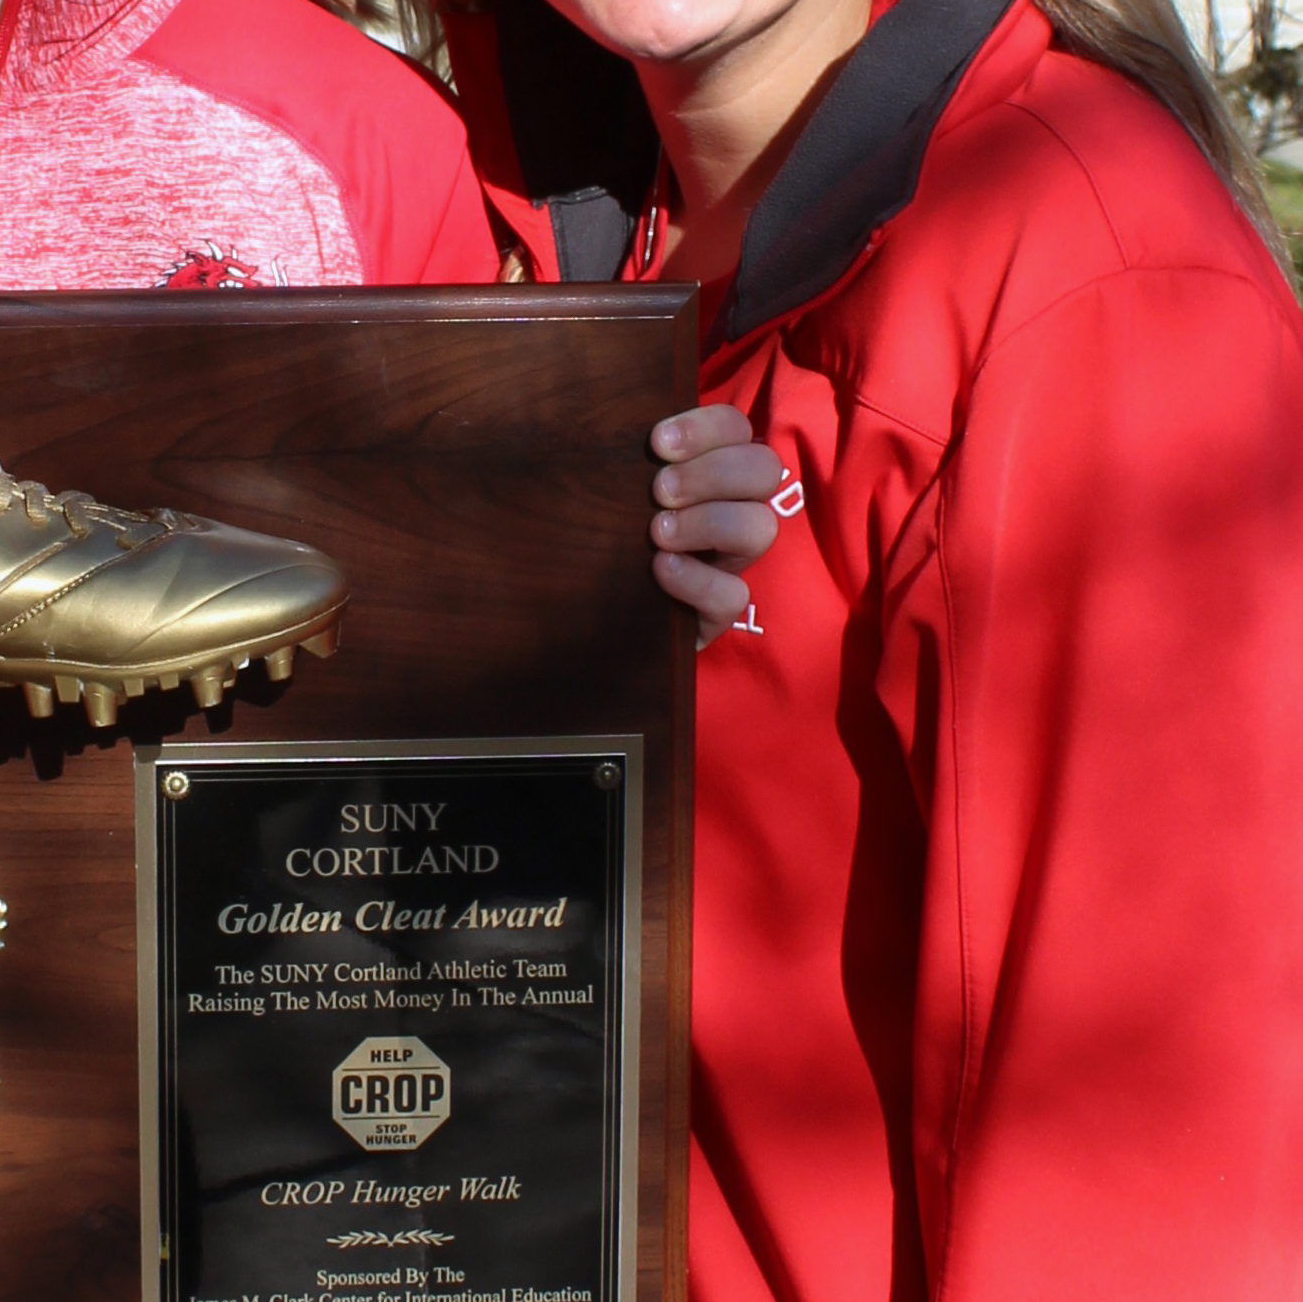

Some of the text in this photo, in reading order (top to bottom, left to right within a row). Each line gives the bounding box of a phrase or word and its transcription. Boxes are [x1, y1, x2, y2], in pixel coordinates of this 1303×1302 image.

[339, 802, 448, 834] SUNY
[285, 845, 499, 878] CORTLAND
[217, 897, 568, 934] Golden Cleat Award
[215, 959, 568, 986] The SUNY Cortland Athletic Team
[188, 985, 594, 1016] Raising The Most Money In The Annual
[370, 1049, 414, 1063] HELP
[340, 1073, 445, 1116] CROP
[366, 1134, 418, 1146] HUNGER
[375, 1124, 408, 1134] STOP
[260, 1176, 522, 1208] CROP Hunger Walk
[316, 1266, 466, 1289] Sponsored By The
